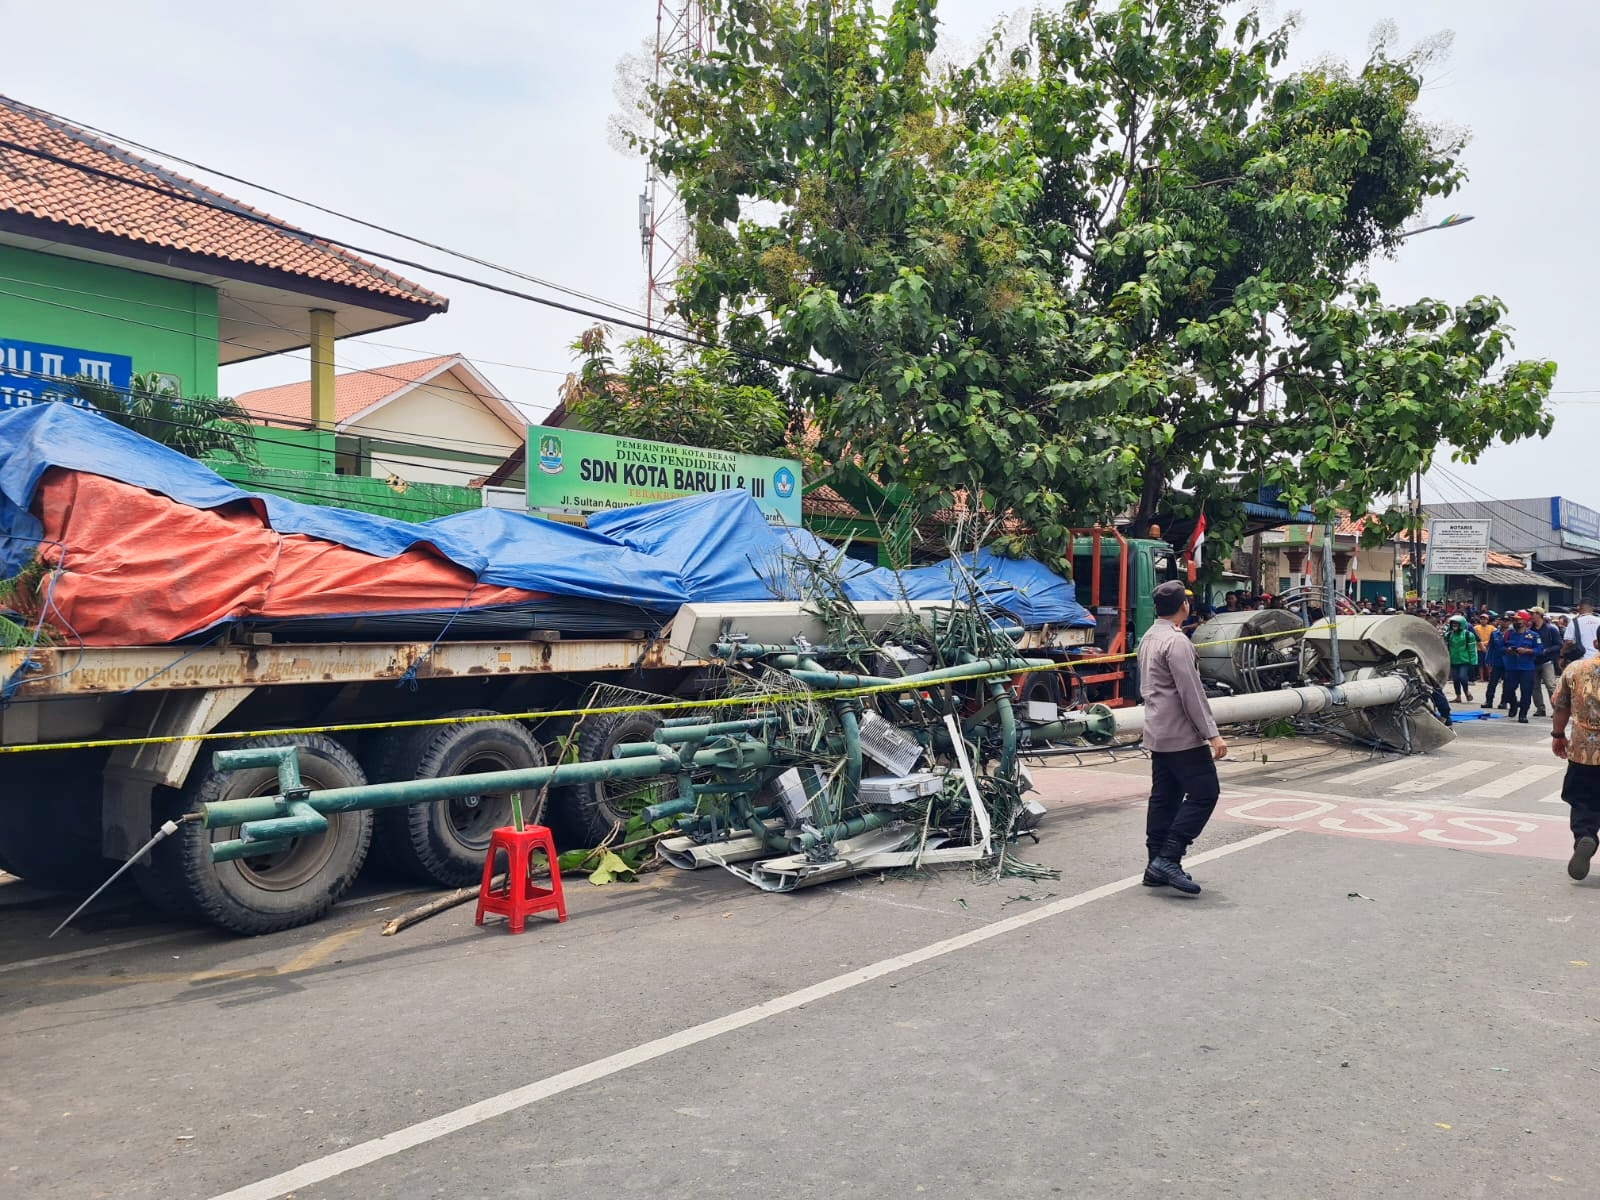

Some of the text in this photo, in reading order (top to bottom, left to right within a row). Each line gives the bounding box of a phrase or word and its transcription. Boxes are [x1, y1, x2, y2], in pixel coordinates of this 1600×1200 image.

[616, 440, 736, 462] PEMERINTAH KOTA BEKASI
[616, 449, 736, 472] DINAS PENDIDIKAN
[580, 458, 617, 484] SDN
[623, 463, 669, 489] KOTA
[674, 469, 716, 493] BARU
[736, 475, 746, 489] &
[751, 478, 765, 499] III
[560, 496, 573, 505] Jl.
[573, 496, 604, 508] Sultan
[134, 665, 171, 681] OLEH
